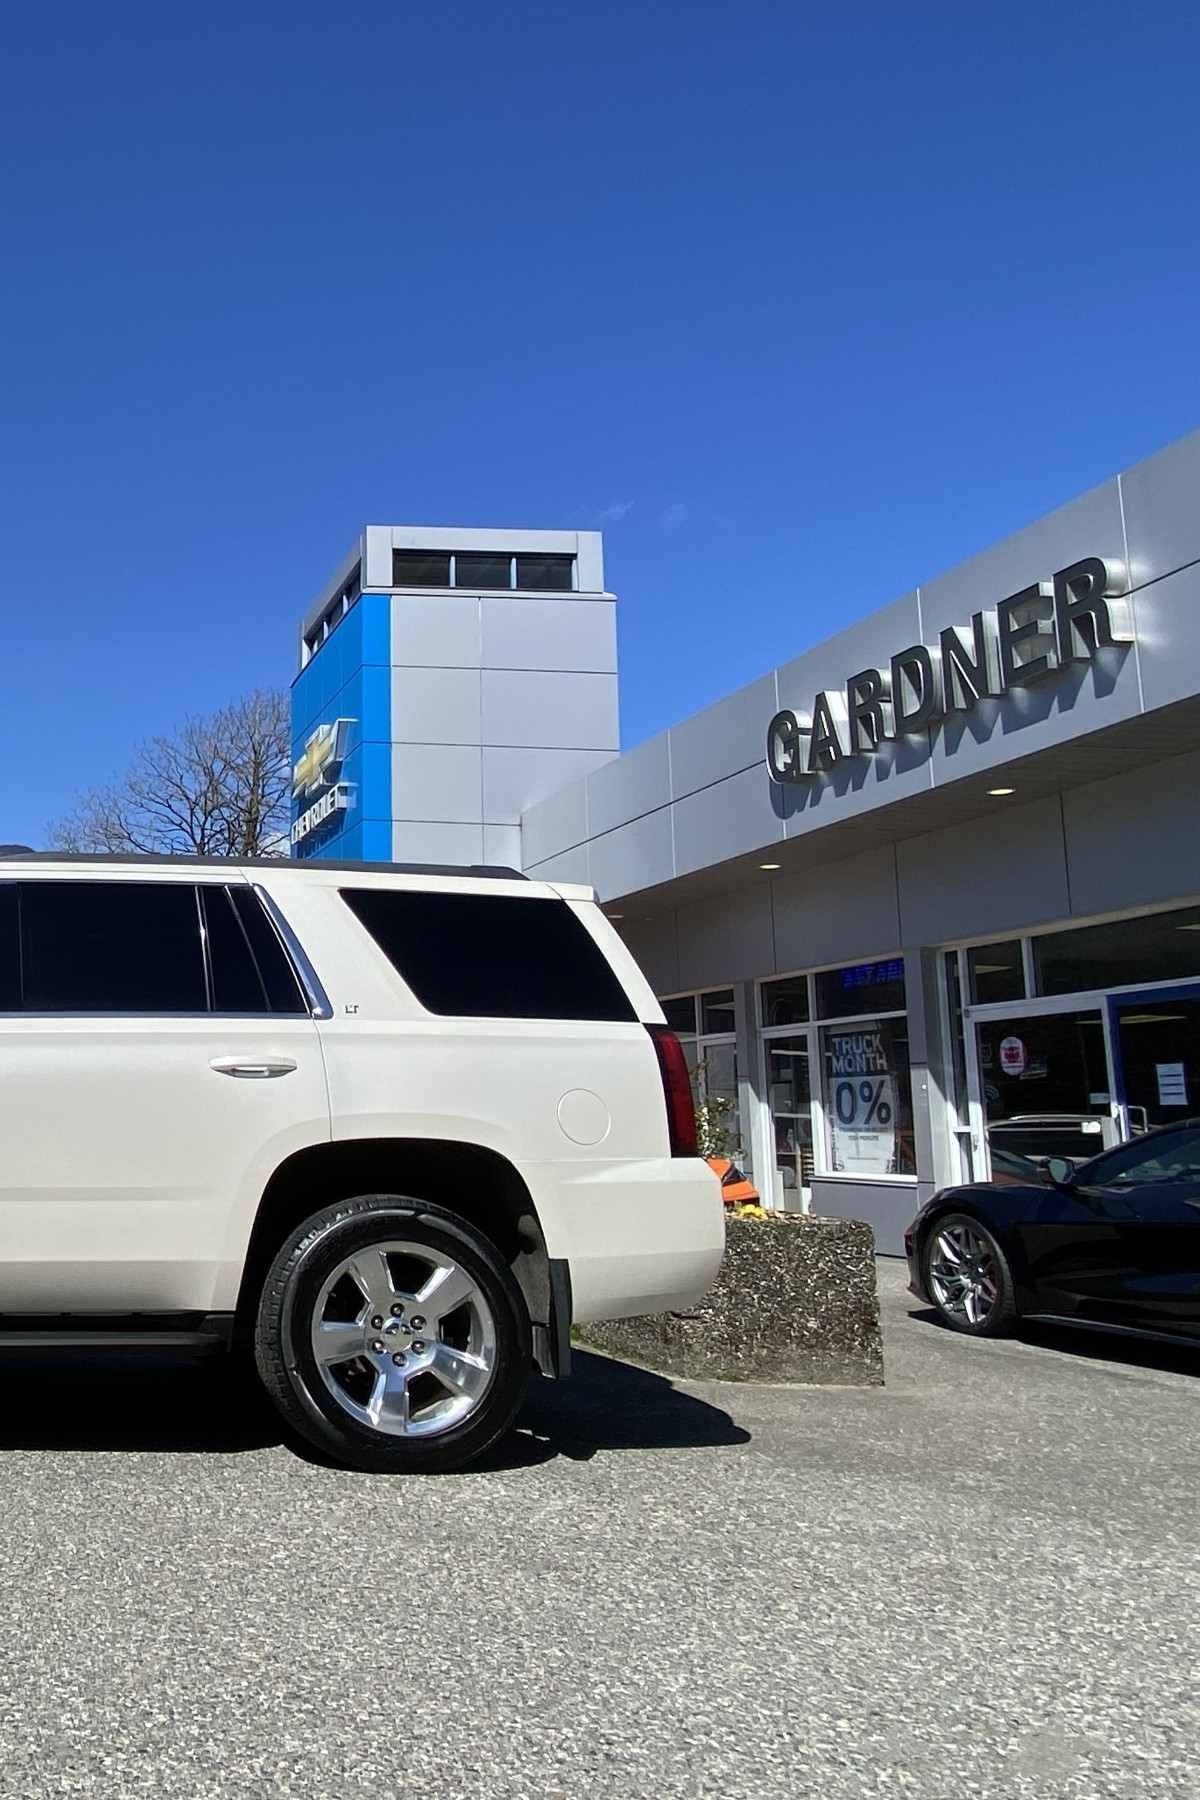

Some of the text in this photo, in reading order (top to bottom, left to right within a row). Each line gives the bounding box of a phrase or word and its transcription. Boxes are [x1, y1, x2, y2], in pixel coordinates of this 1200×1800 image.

[766, 557, 1135, 784] GARDNER
[832, 1034, 883, 1056] TRUCK
[832, 1052, 887, 1073] MONTH
[836, 1080, 891, 1125] 0%
